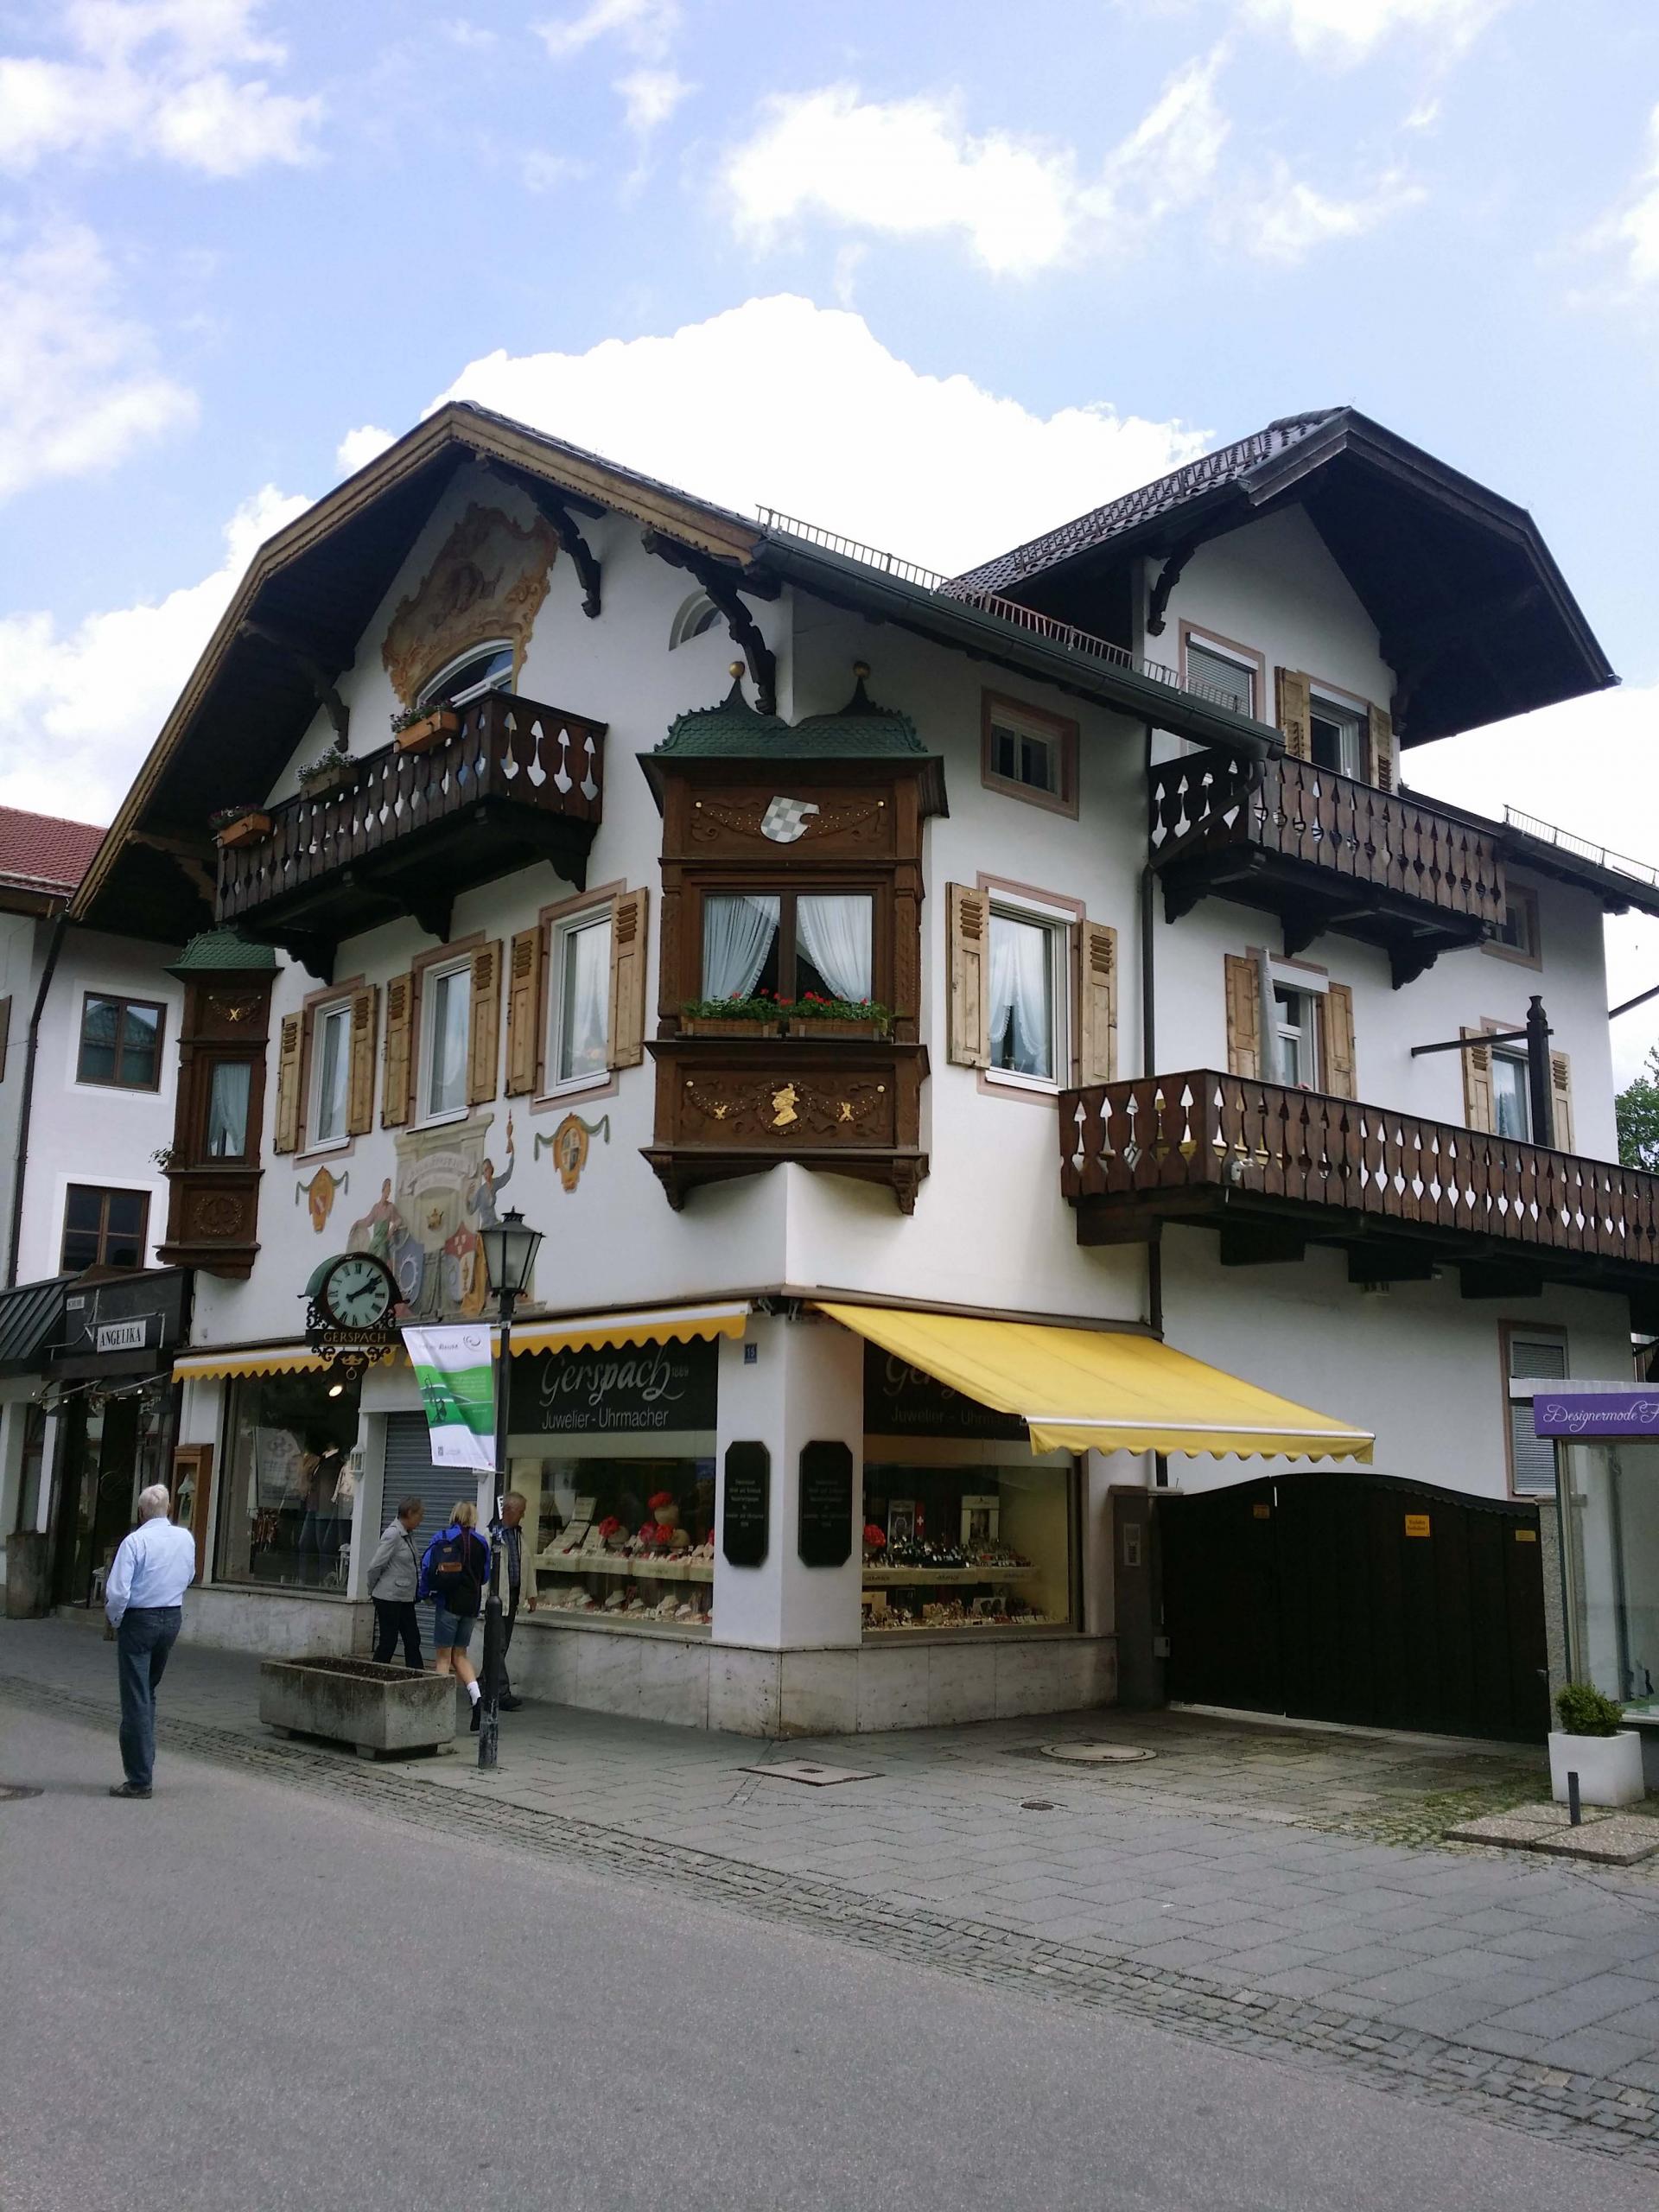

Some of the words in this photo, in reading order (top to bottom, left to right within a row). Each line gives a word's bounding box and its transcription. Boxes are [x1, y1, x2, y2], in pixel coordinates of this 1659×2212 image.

[100, 1326, 141, 1346] ANGELIKA
[323, 1332, 386, 1343] GERSPACH
[539, 1345, 684, 1407] Gerspach
[542, 1409, 589, 1430] Juwelier
[599, 1408, 669, 1427] Uhrmacher
[1543, 1401, 1645, 1432] Designermode
